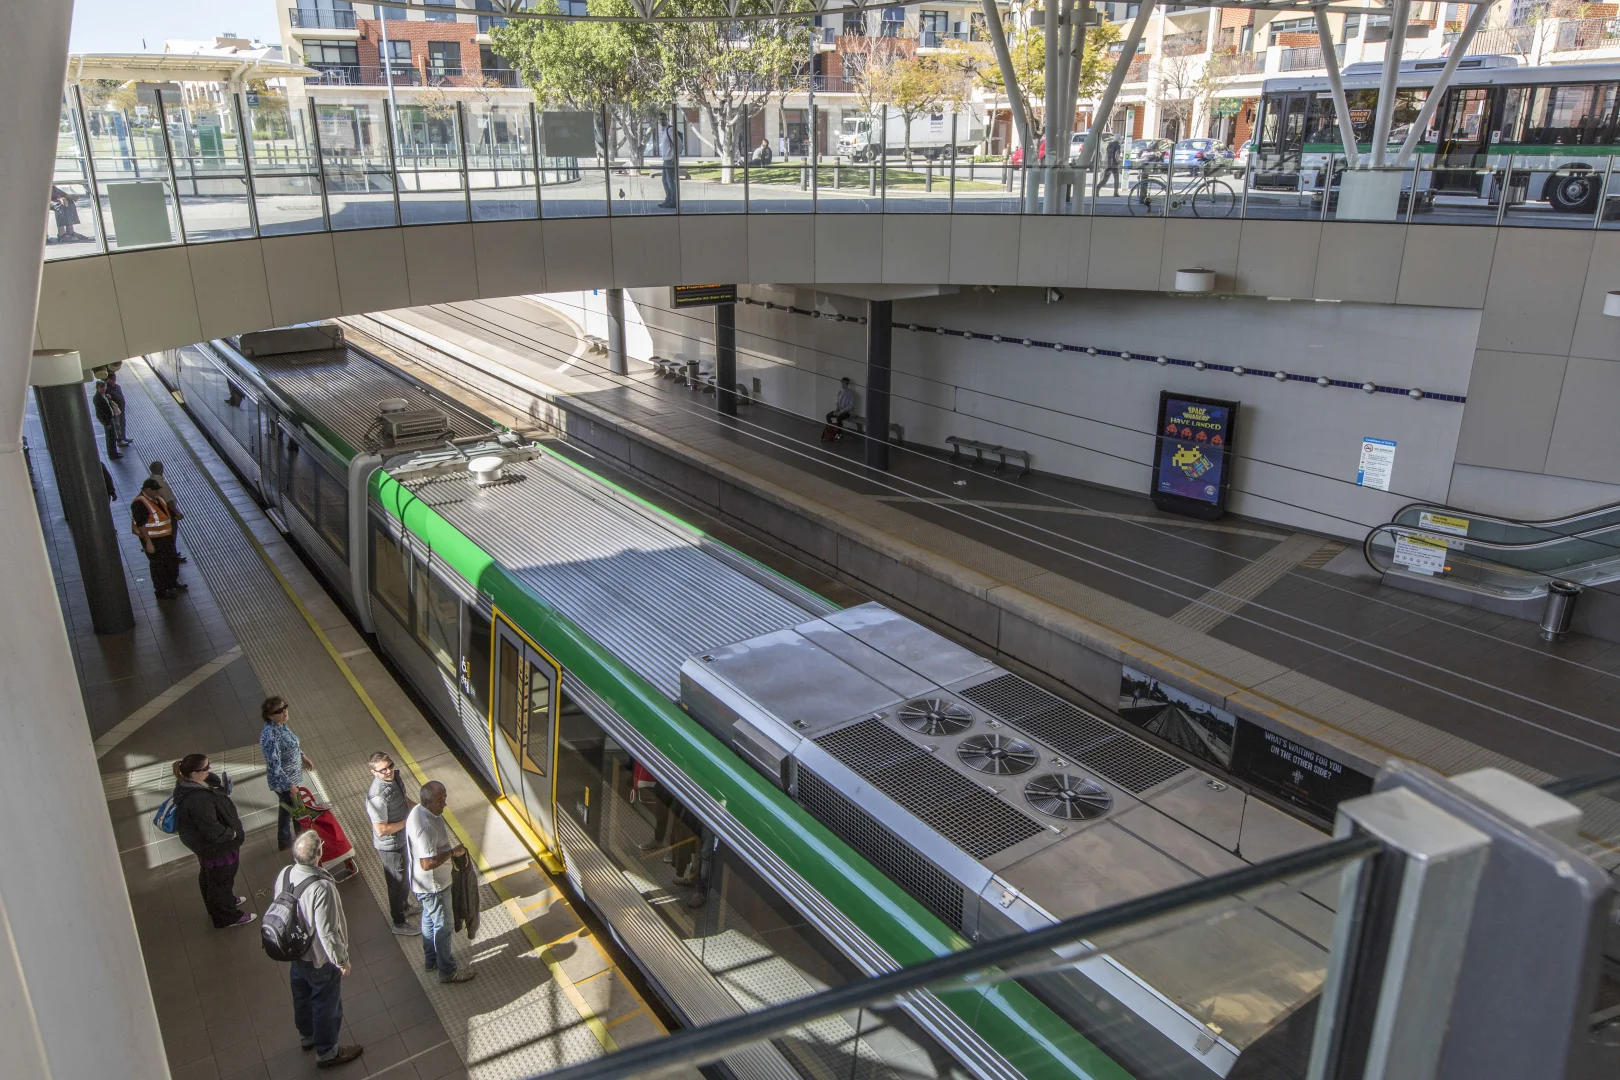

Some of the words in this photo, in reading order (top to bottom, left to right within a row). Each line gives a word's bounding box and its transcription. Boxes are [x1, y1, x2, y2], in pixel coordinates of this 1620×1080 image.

[1182, 412, 1211, 421] INVADERS
[1187, 406, 1207, 415] SPACE
[1170, 417, 1190, 425] HAVE
[1191, 421, 1221, 430] LANDED
[1265, 731, 1288, 748] WHAT'S
[1288, 741, 1315, 760] WAITING
[1315, 754, 1328, 767] FOR
[1329, 760, 1343, 774] YOU
[1270, 744, 1280, 756] ON
[1280, 749, 1292, 762] THE
[1292, 755, 1313, 771] OTHER
[1313, 764, 1332, 780] SIDE?
